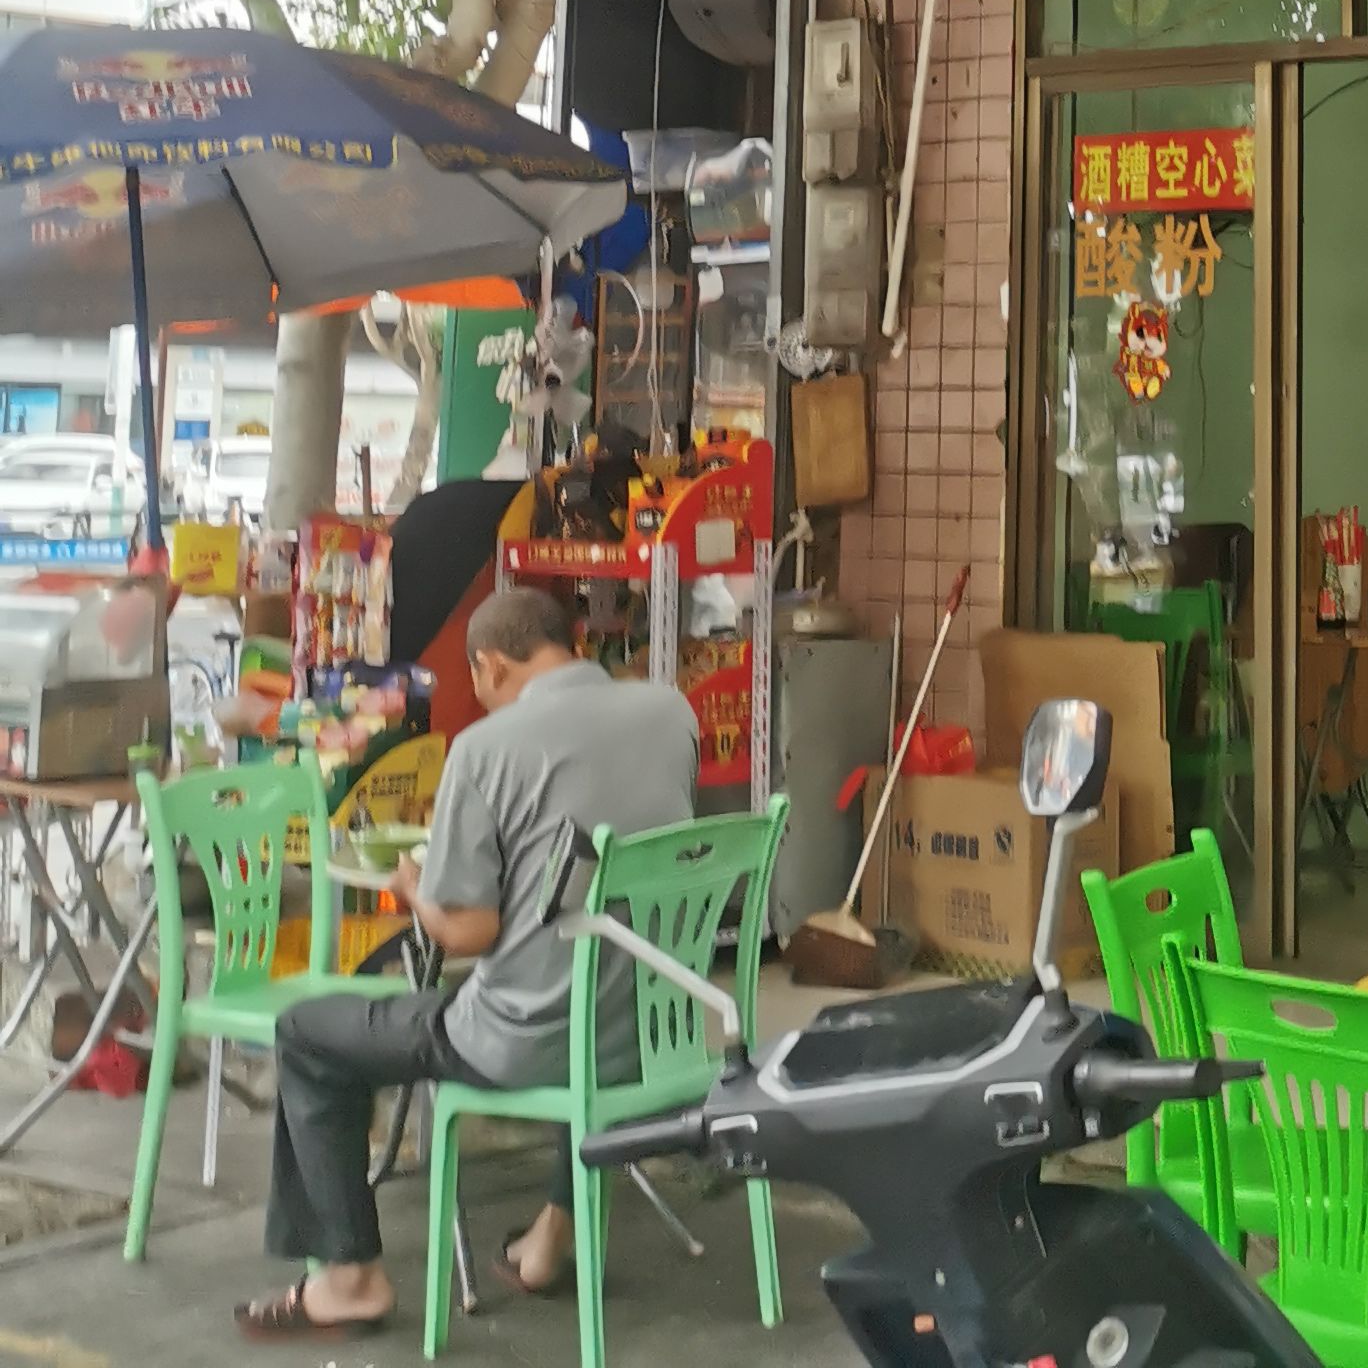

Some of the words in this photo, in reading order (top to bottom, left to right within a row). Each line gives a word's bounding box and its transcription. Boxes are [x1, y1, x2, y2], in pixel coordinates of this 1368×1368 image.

[1080, 134, 1256, 204] 酒糟空心菜
[1076, 214, 1223, 299] 酸粉
